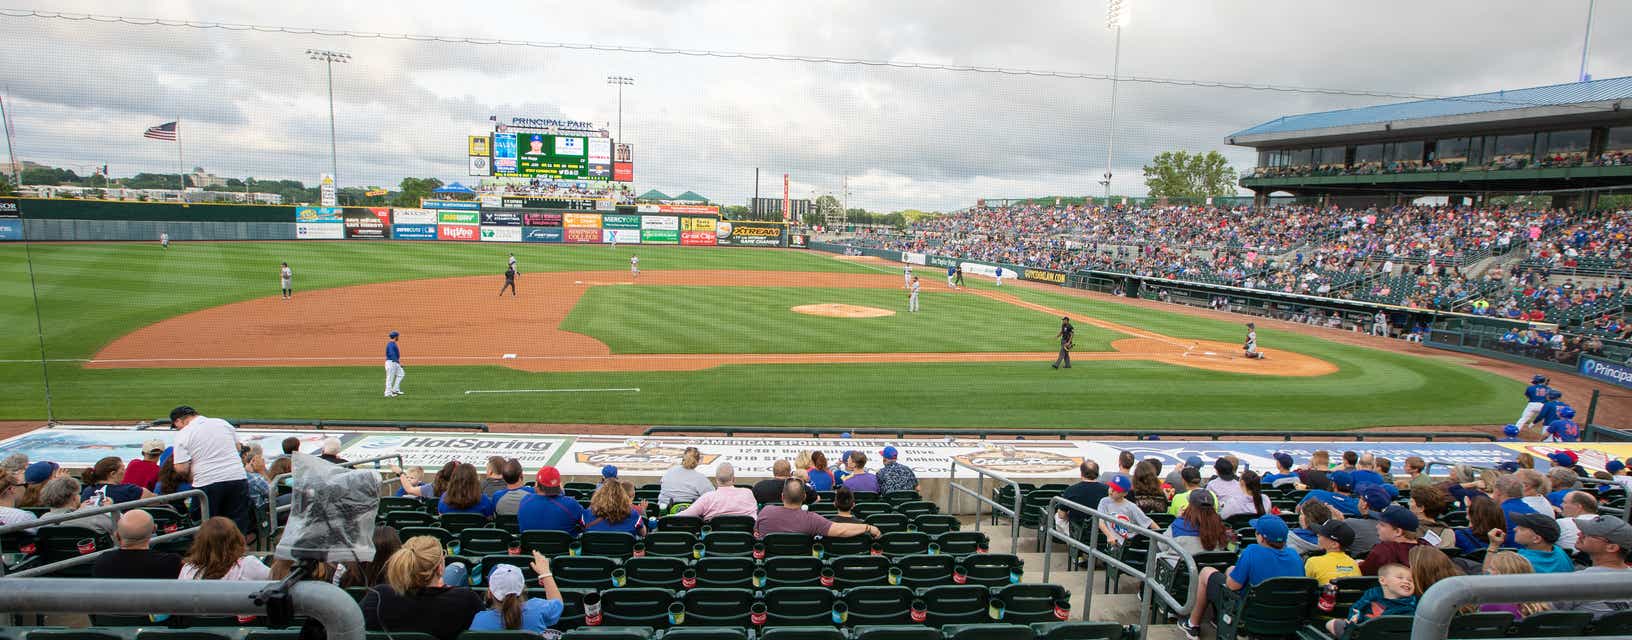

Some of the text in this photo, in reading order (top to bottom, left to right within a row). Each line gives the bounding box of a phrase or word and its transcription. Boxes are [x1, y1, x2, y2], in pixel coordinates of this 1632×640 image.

[512, 117, 593, 129] PRINCIPAL PARK
[401, 437, 554, 452] HotSpring
